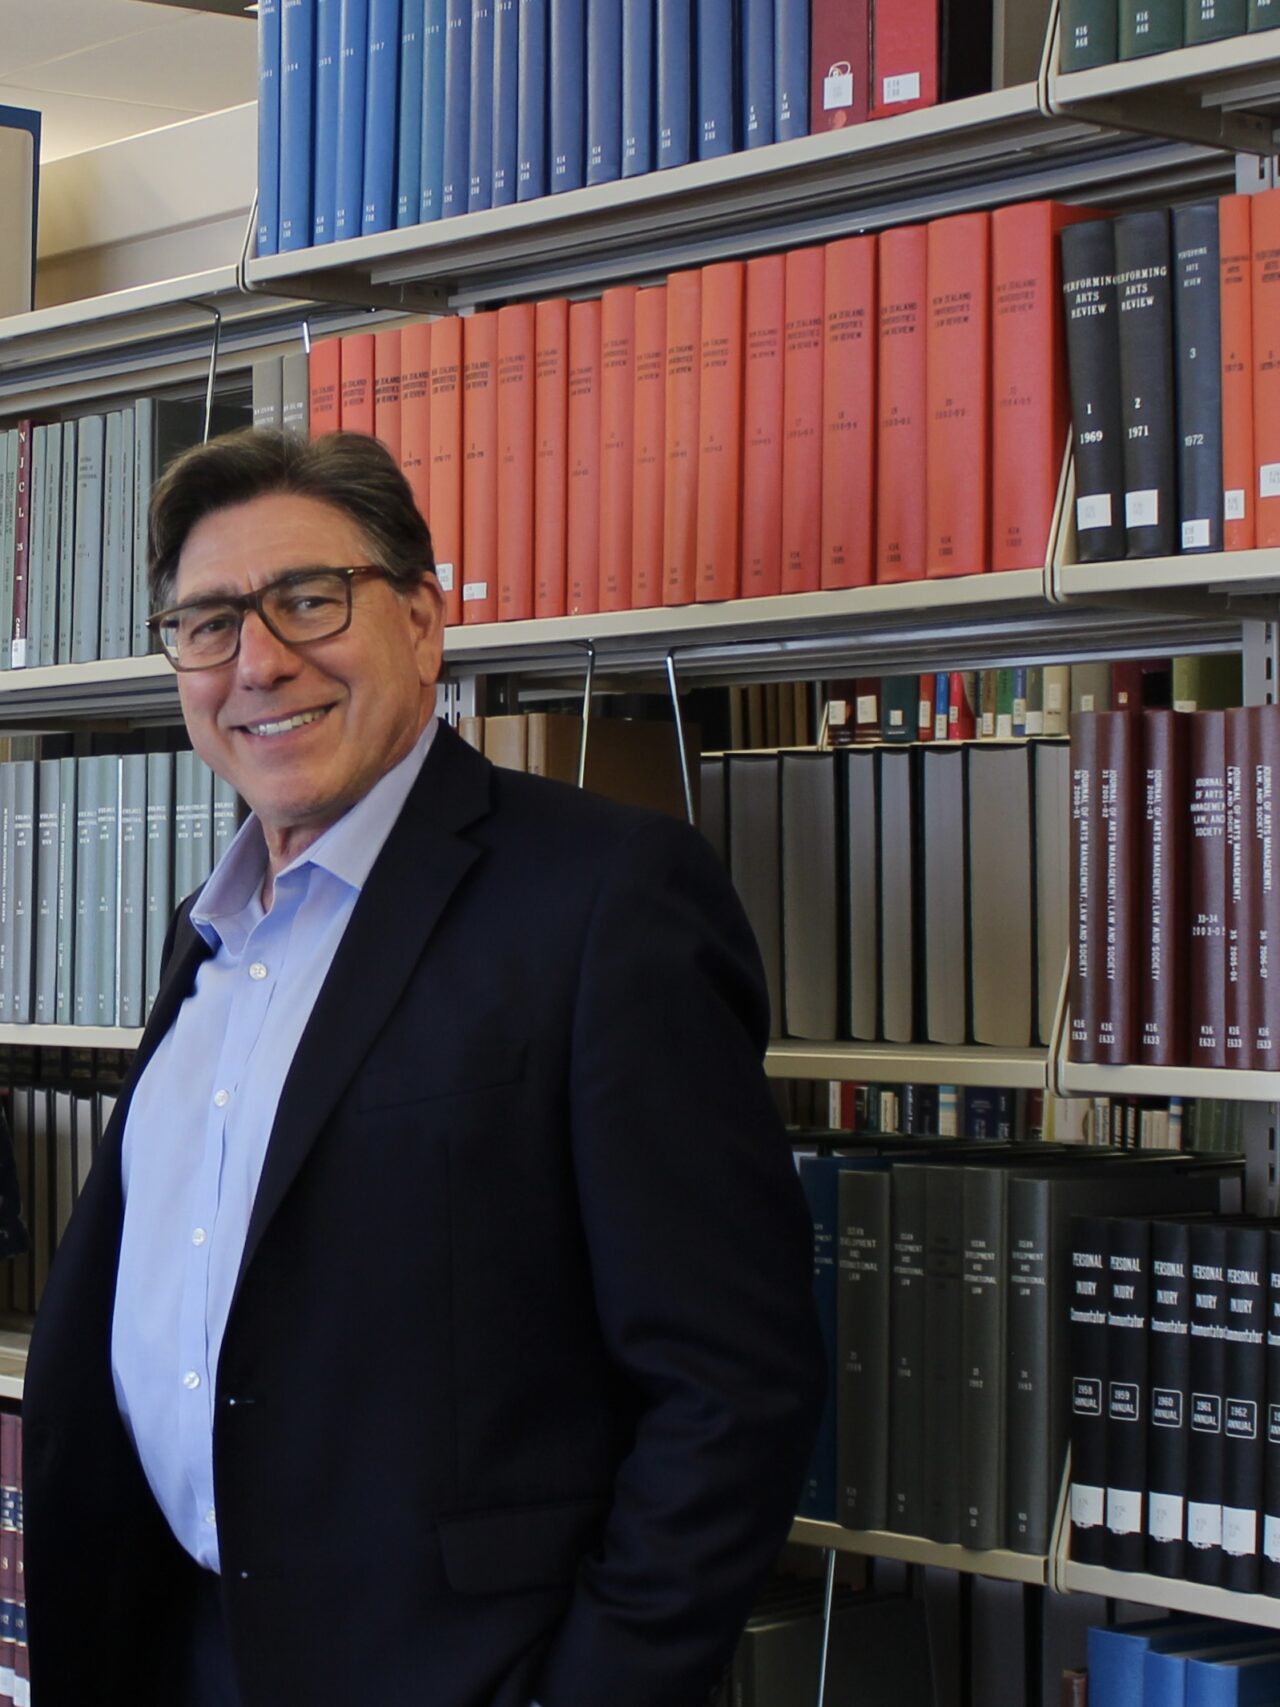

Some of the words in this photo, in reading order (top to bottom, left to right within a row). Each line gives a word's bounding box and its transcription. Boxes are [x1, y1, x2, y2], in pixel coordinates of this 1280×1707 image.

[1136, 23, 1149, 34] A68
[1076, 38, 1088, 48] A68
[1125, 283, 1148, 296] ARTS
[1076, 292, 1099, 304] ARTS
[1121, 296, 1154, 311] REVIEW
[1071, 304, 1107, 319] REVIEW
[1134, 398, 1141, 409] 2
[1080, 430, 1103, 444] 1969
[1128, 425, 1149, 439] 1971
[1184, 434, 1204, 446] 1972
[1195, 778, 1223, 786] JOURNAL
[1195, 790, 1203, 799] OF
[1205, 790, 1224, 799] ARTS
[1080, 806, 1088, 818] OF
[1109, 807, 1117, 818] OF
[1154, 806, 1162, 818] OF
[1194, 815, 1209, 825] LAW,
[1210, 814, 1225, 824] AND
[1080, 820, 1088, 841] ARTS
[1153, 820, 1161, 841] ARTS
[1195, 827, 1223, 837] SOCIETY
[1079, 903, 1088, 921] LAW
[1152, 905, 1160, 924] LAW
[1079, 924, 1088, 940] AND
[1152, 926, 1160, 944] AND
[1079, 944, 1088, 977] SOCIETY
[1107, 946, 1115, 980] SOCIETY
[1152, 946, 1160, 980] SOCIETY
[1073, 1252, 1103, 1268] PERSONAL
[1110, 1256, 1141, 1272] PERSONAL
[1154, 1261, 1185, 1277] PERSONAL
[1193, 1264, 1224, 1281] PERSONAL
[1228, 1269, 1260, 1286] PERSONAL
[1231, 1406, 1247, 1417] 1962
